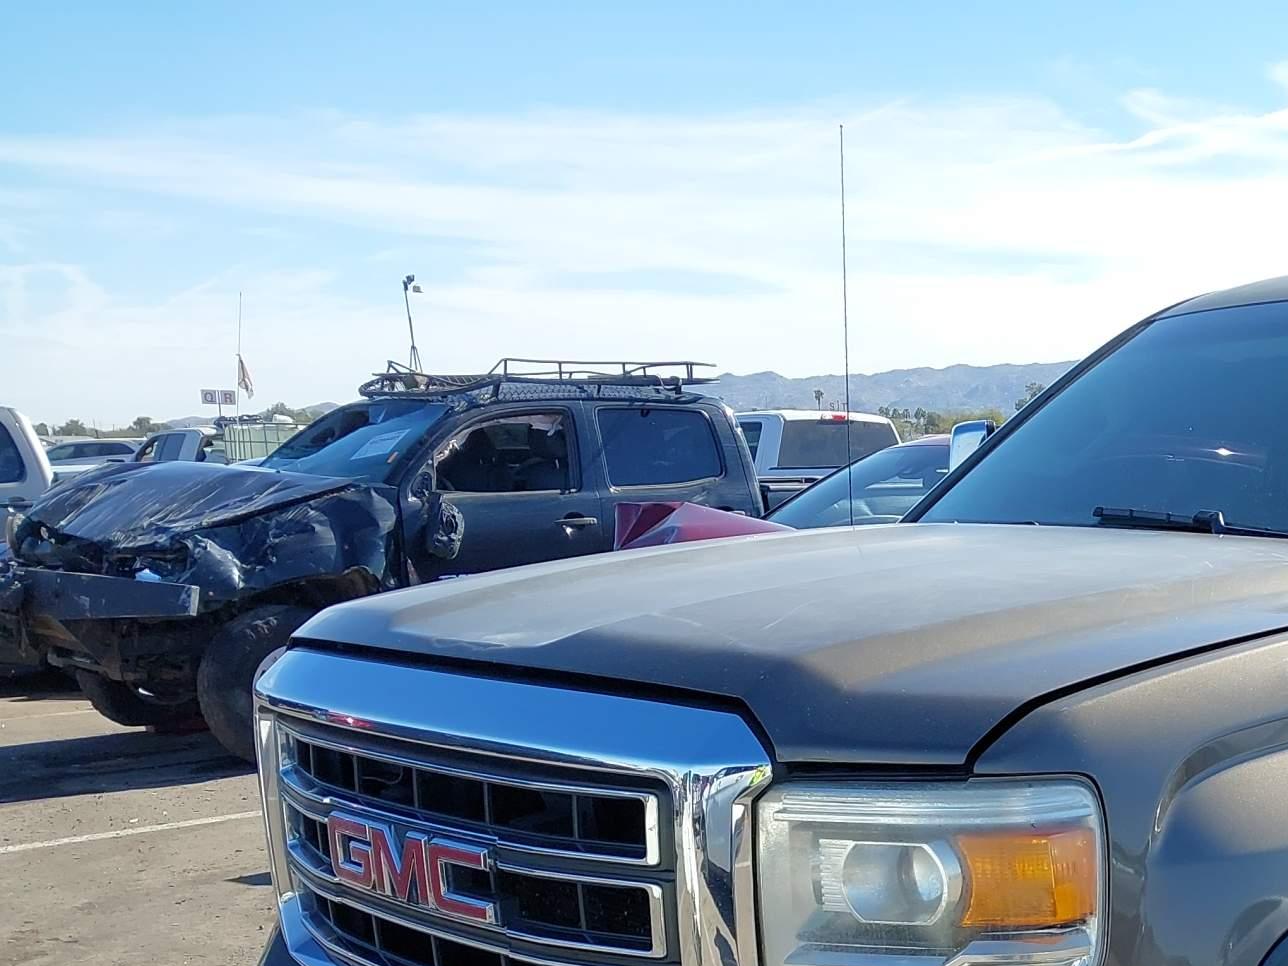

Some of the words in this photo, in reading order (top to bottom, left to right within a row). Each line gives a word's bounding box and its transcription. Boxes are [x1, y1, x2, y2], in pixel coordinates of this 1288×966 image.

[203, 391, 216, 403] Q
[223, 392, 233, 403] R
[327, 811, 499, 925] GMC
